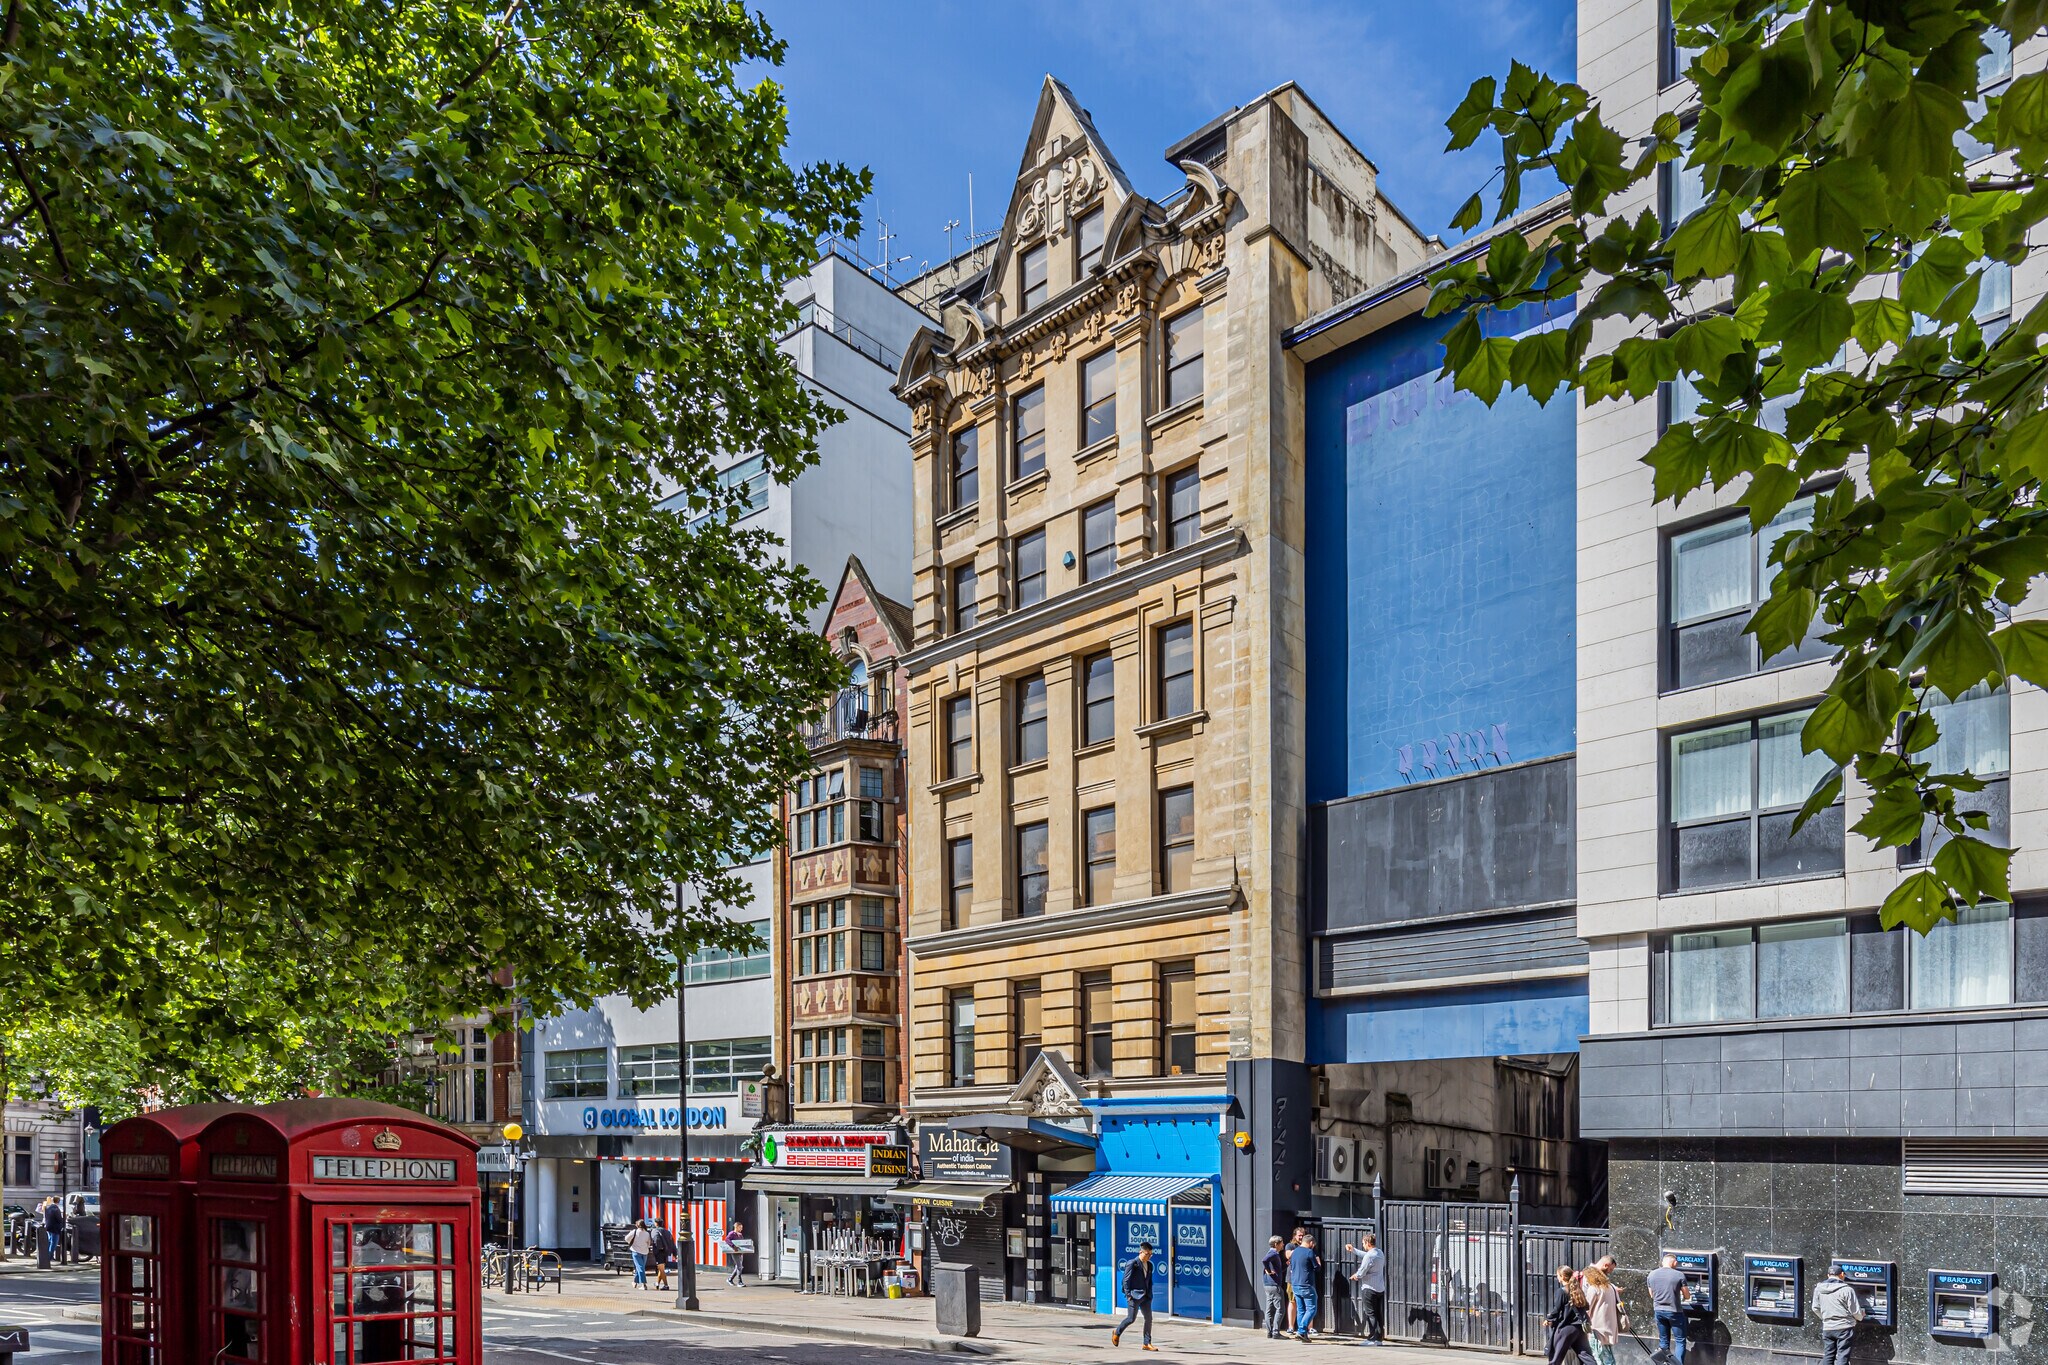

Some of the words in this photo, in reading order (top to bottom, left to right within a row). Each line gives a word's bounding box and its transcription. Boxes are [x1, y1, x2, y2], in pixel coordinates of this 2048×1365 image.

[1045, 1088, 1056, 1102] 19
[600, 1108, 656, 1128] GLOBAL
[486, 1152, 499, 1165] WITH
[872, 1149, 907, 1159] INDIAN
[952, 1153, 960, 1162] of
[959, 1153, 975, 1162] india
[115, 1155, 170, 1173] TELEPHONE
[215, 1155, 277, 1176] TELEPHONE
[318, 1158, 451, 1179] TELEPHONE
[871, 1164, 907, 1175] CUISINE
[912, 1197, 930, 1205] INDIAN
[932, 1199, 954, 1207] CUISINE
[1130, 1223, 1157, 1237] OPA
[1179, 1225, 1205, 1238] OPA
[1759, 1260, 1790, 1268] BARCLAYS
[1848, 1265, 1882, 1273] BARCLAYS
[1946, 1276, 1982, 1285] BARCLAYS
